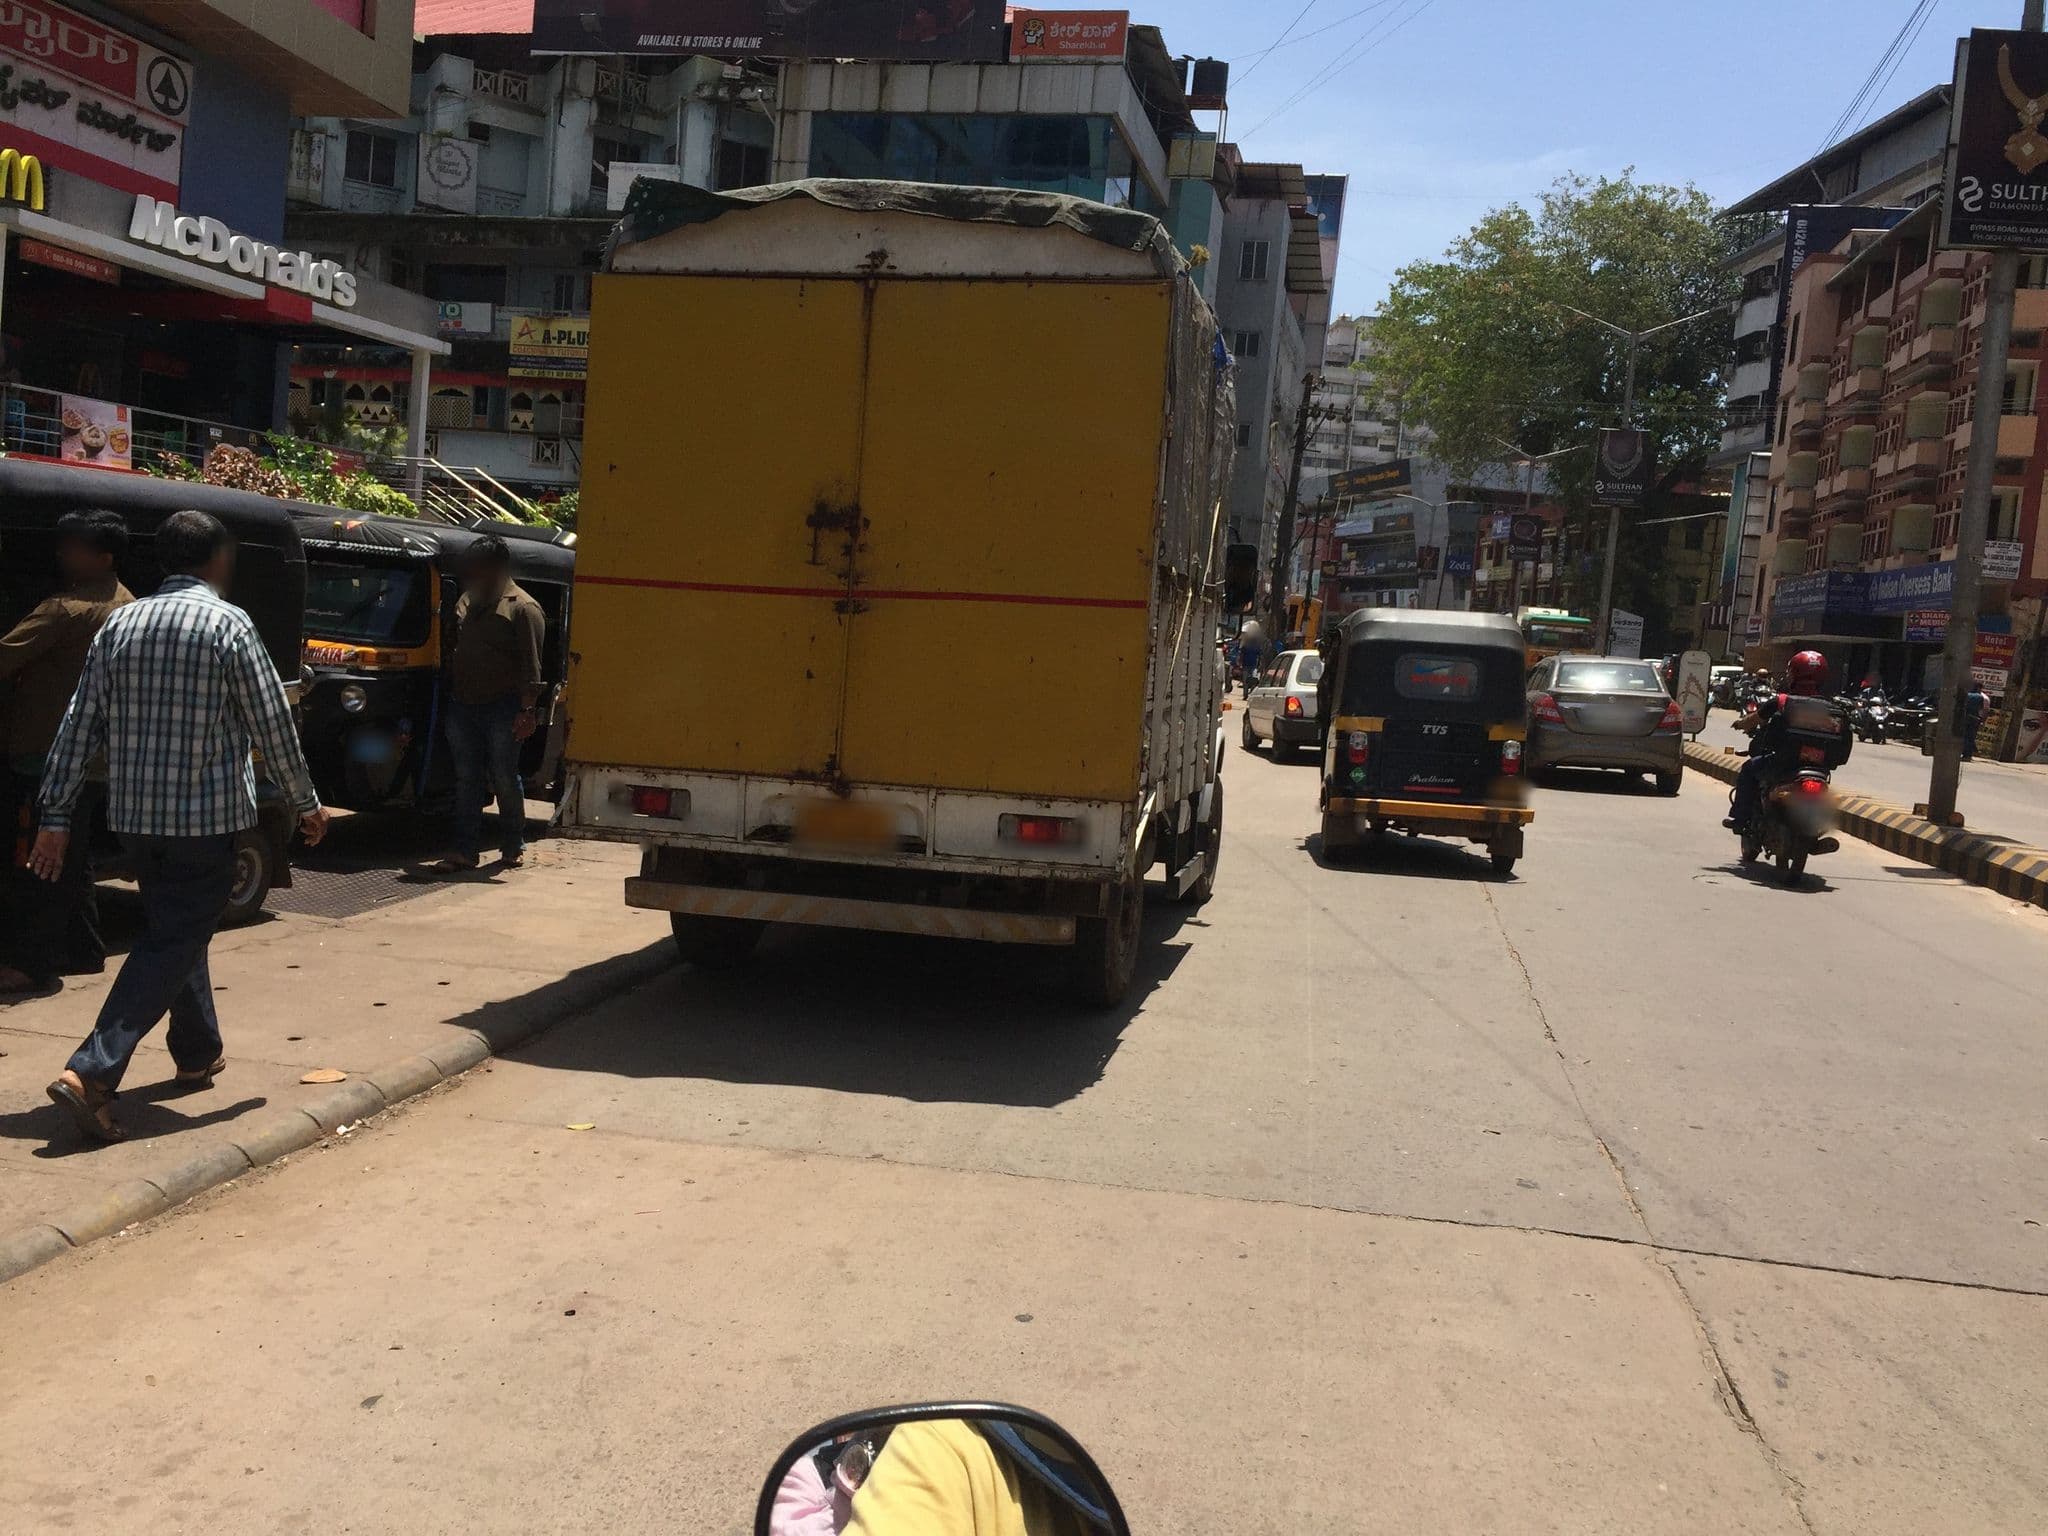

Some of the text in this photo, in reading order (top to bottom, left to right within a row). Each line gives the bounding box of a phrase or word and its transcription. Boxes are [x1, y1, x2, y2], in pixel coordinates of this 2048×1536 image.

[637, 34, 681, 47] AVAILABLE
[681, 36, 693, 47] IN
[692, 36, 724, 48] STORES
[732, 37, 763, 49] ONLINE
[1989, 201, 2044, 212] DIAMONDS
[129, 194, 357, 307] McDonald's
[1606, 482, 1643, 491] SULTHAN
[1932, 565, 1953, 593] Bank
[1422, 724, 1449, 735] TVS
